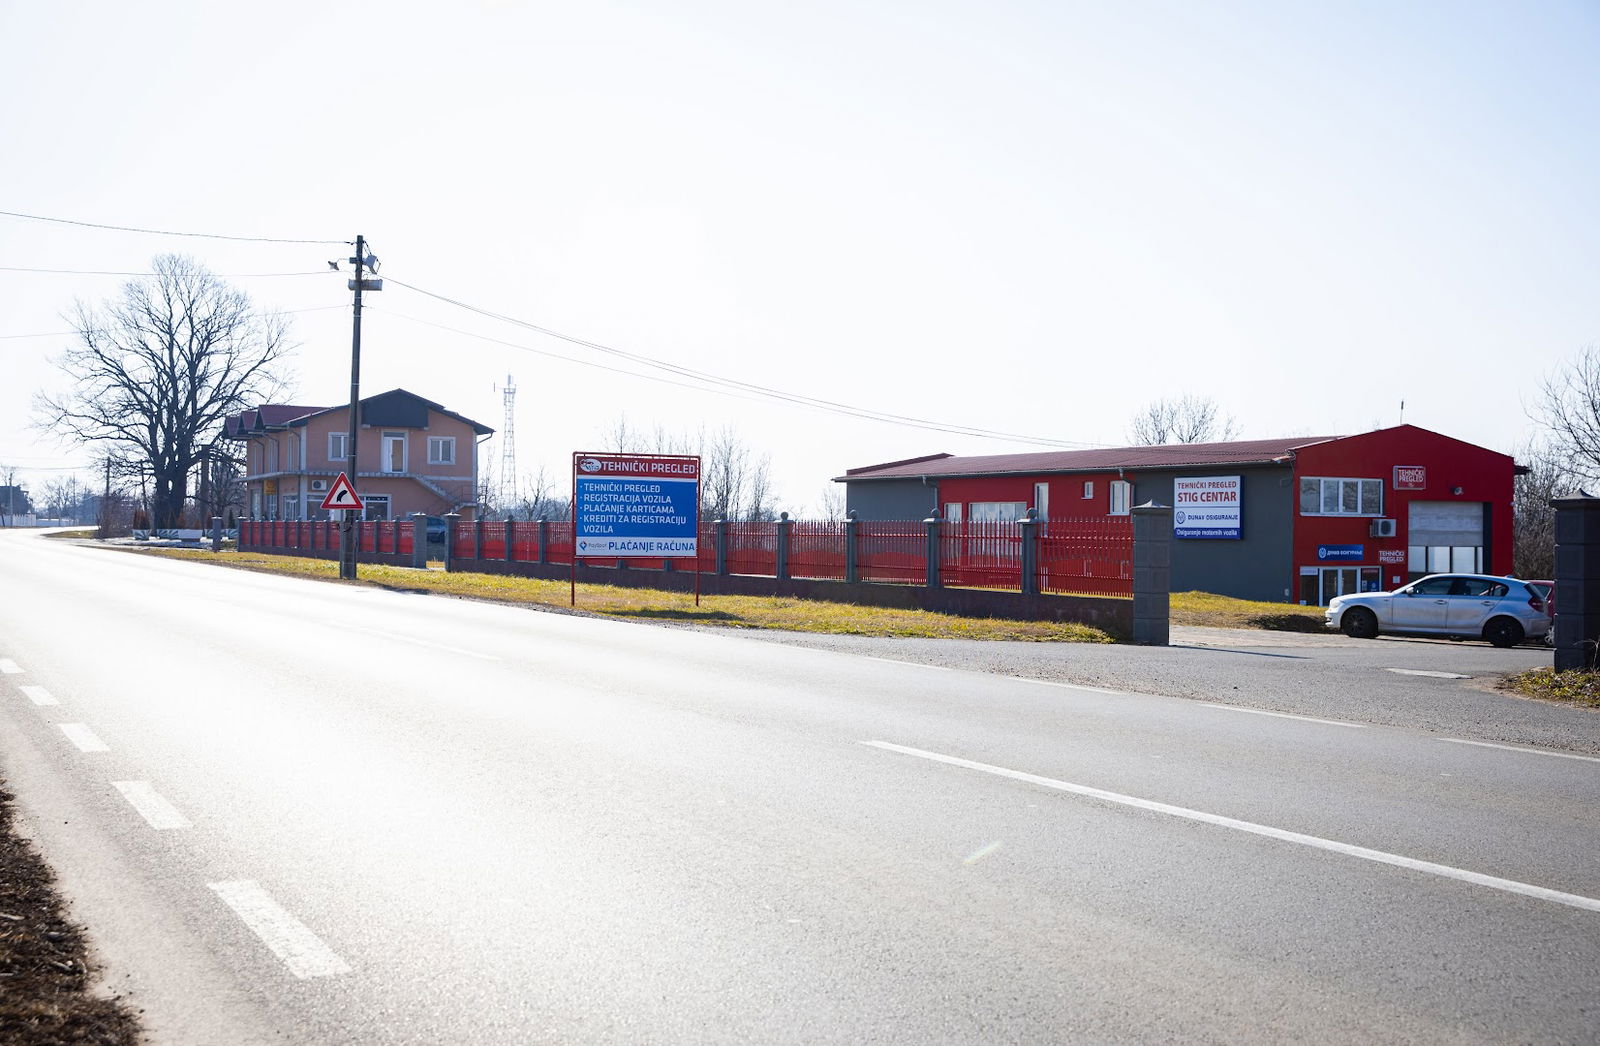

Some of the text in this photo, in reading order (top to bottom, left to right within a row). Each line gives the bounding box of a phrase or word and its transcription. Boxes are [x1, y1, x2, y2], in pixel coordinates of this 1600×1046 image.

[601, 460, 696, 474] TEHNIČKI PREGLED
[584, 482, 660, 493] TEHNIČKI PREGLED
[584, 494, 672, 504] REGISTRACIJA VOZILA
[1177, 491, 1237, 502] STIG CENTAR
[583, 503, 675, 514] PLAĆANJE KARTICAMA
[583, 514, 687, 525] KREDITI ZA REGISTRACIJU
[583, 525, 614, 533] VOZILA
